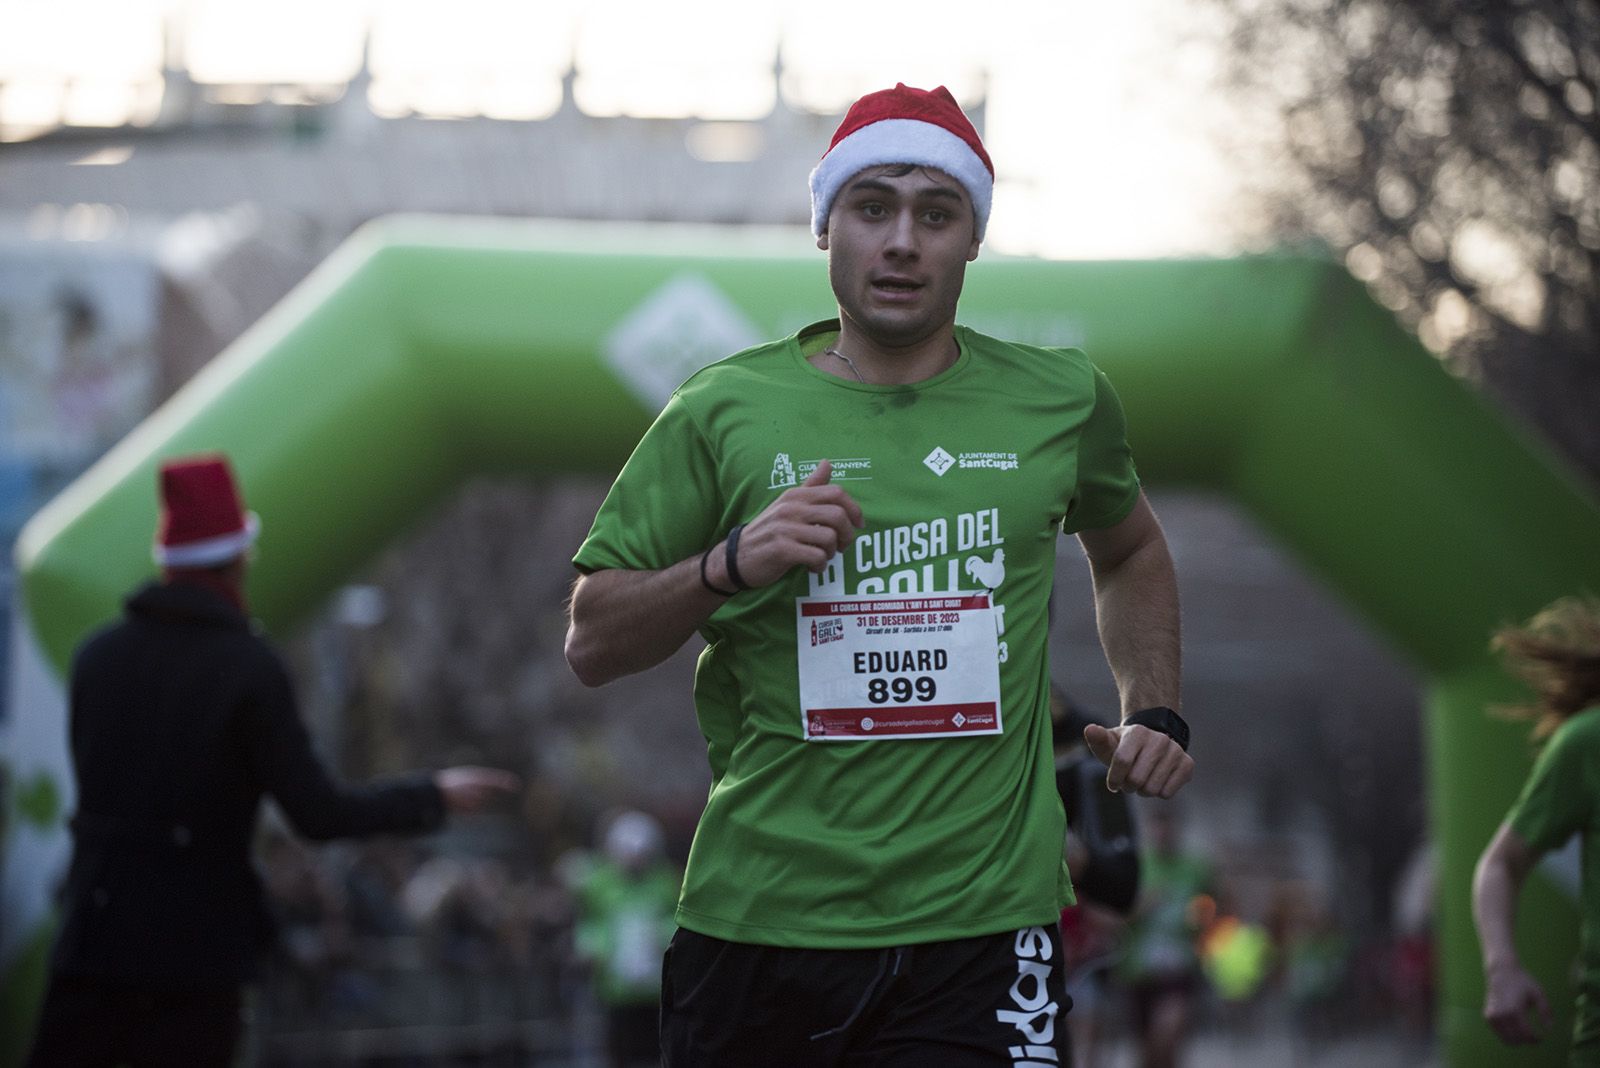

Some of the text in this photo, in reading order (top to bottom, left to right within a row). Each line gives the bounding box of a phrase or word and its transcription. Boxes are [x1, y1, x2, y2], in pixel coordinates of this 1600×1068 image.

[959, 459, 1019, 470] SantCugat
[855, 507, 1005, 573] CURSA DEL
[856, 612, 960, 627] 31 DE DESEMBRE DE 2023
[854, 649, 948, 674] EDUARD
[868, 676, 937, 704] 899
[996, 926, 1060, 1068] idas
